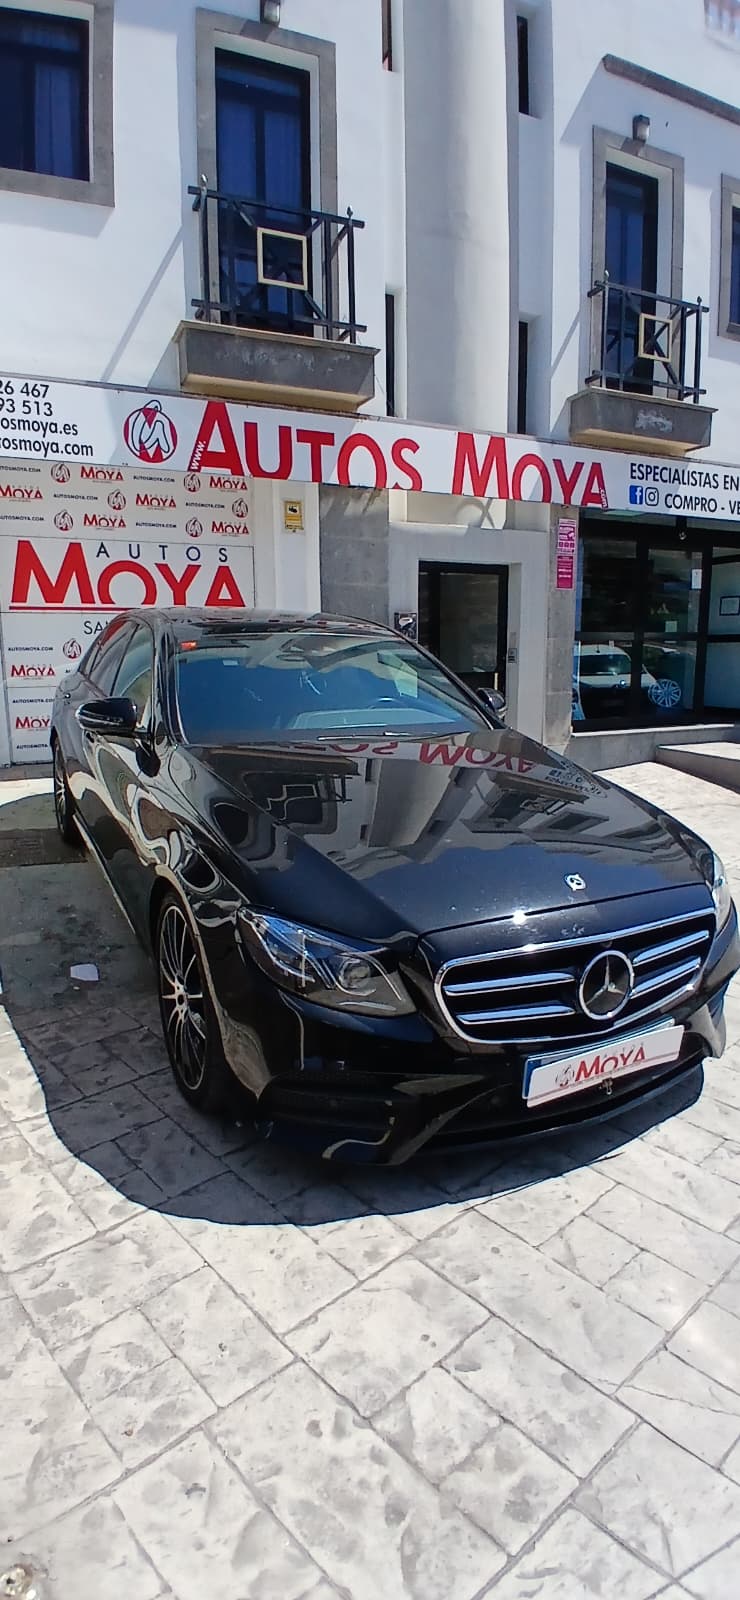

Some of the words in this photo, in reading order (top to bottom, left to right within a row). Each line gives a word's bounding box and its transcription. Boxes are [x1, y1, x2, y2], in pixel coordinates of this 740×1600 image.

[20, 382, 49, 398] 467
[22, 400, 53, 417] 513
[187, 400, 423, 492] AUTOS
[452, 431, 608, 507] MOYA
[80, 465, 124, 481] MOYA
[630, 463, 719, 489] ESPECIALISTAS
[723, 475, 740, 491] EN
[209, 476, 248, 490] MOYA
[0, 485, 43, 500] MOYA
[136, 494, 176, 508] MOYA
[664, 493, 718, 513] COMPRO
[83, 513, 126, 528] MOYA
[211, 521, 249, 534] MOYA
[96, 542, 228, 563] AUTOS
[11, 540, 246, 607] MOYA
[84, 620, 108, 635] SA
[11, 664, 55, 677] MOYA
[575, 1046, 645, 1082] MOYA
